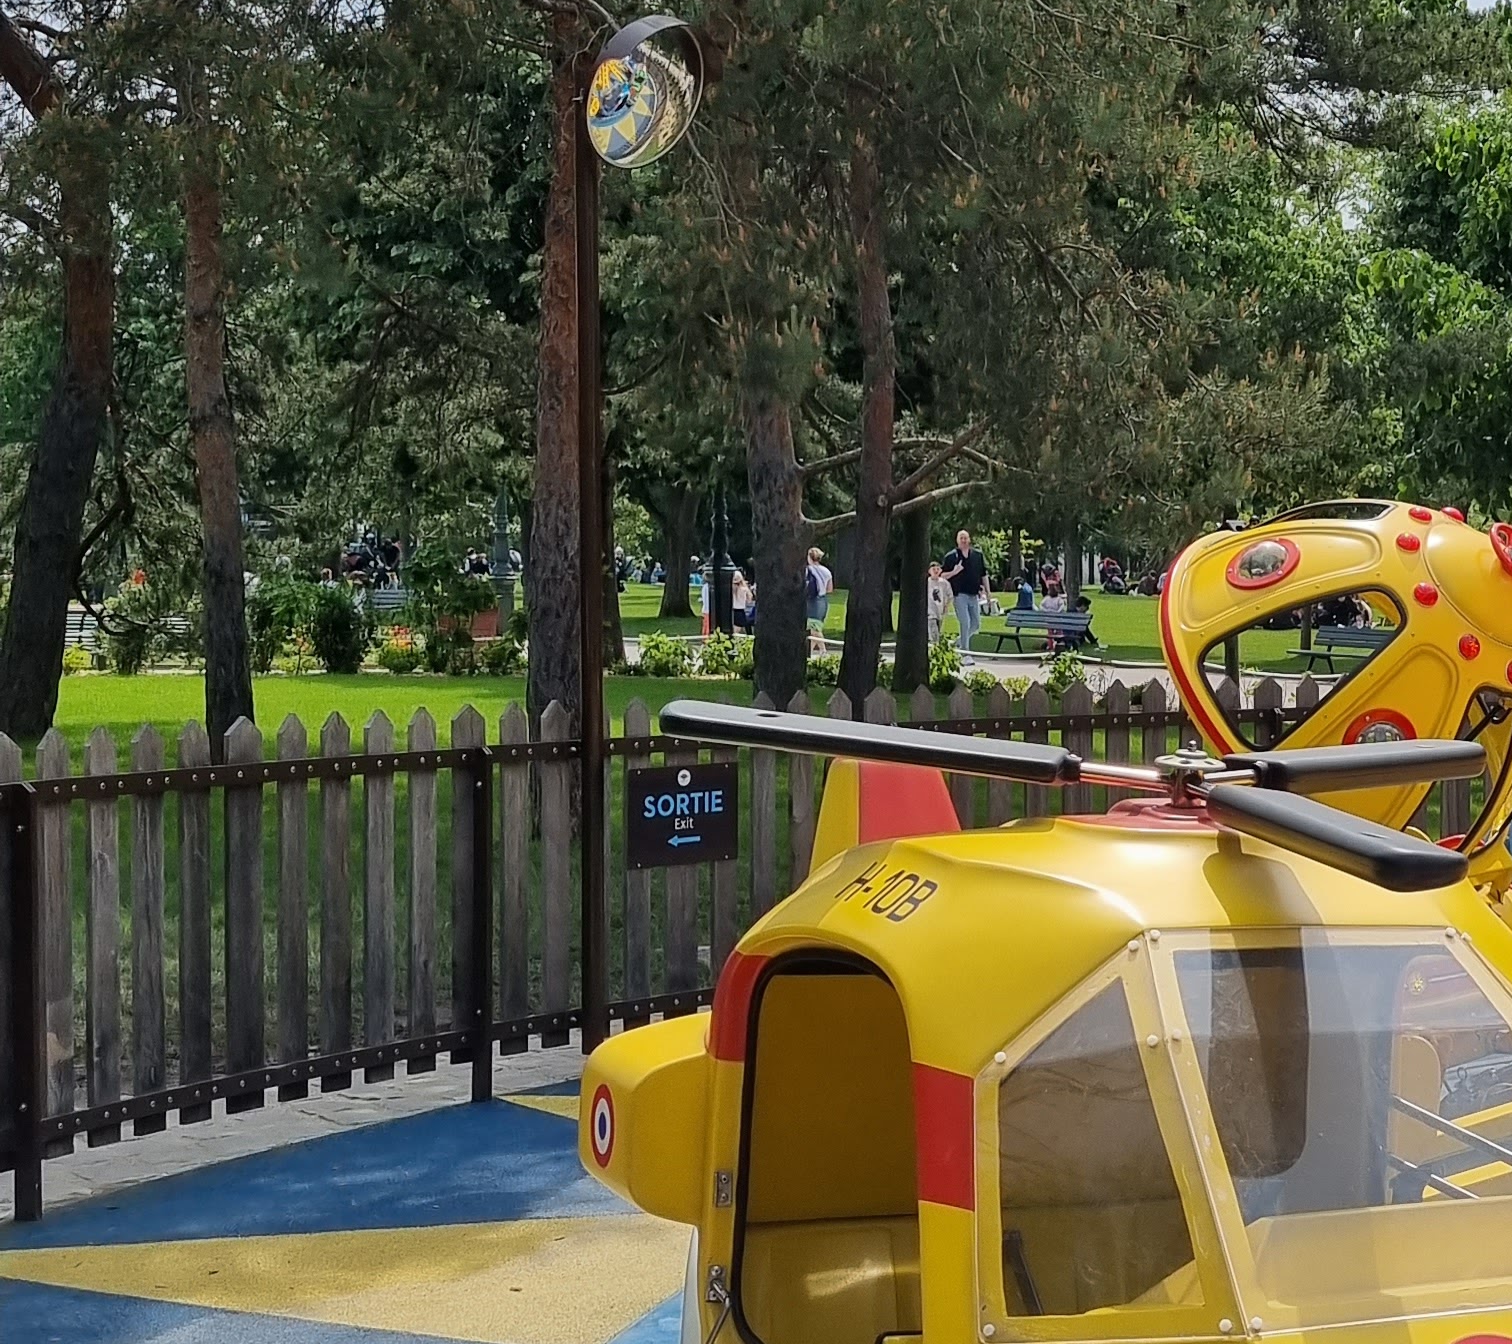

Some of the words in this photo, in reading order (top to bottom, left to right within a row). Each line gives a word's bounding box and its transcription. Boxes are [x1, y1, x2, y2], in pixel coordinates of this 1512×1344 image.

[643, 790, 724, 818] SORTIE
[674, 816, 695, 830] Exit
[833, 861, 939, 923] H-10B
